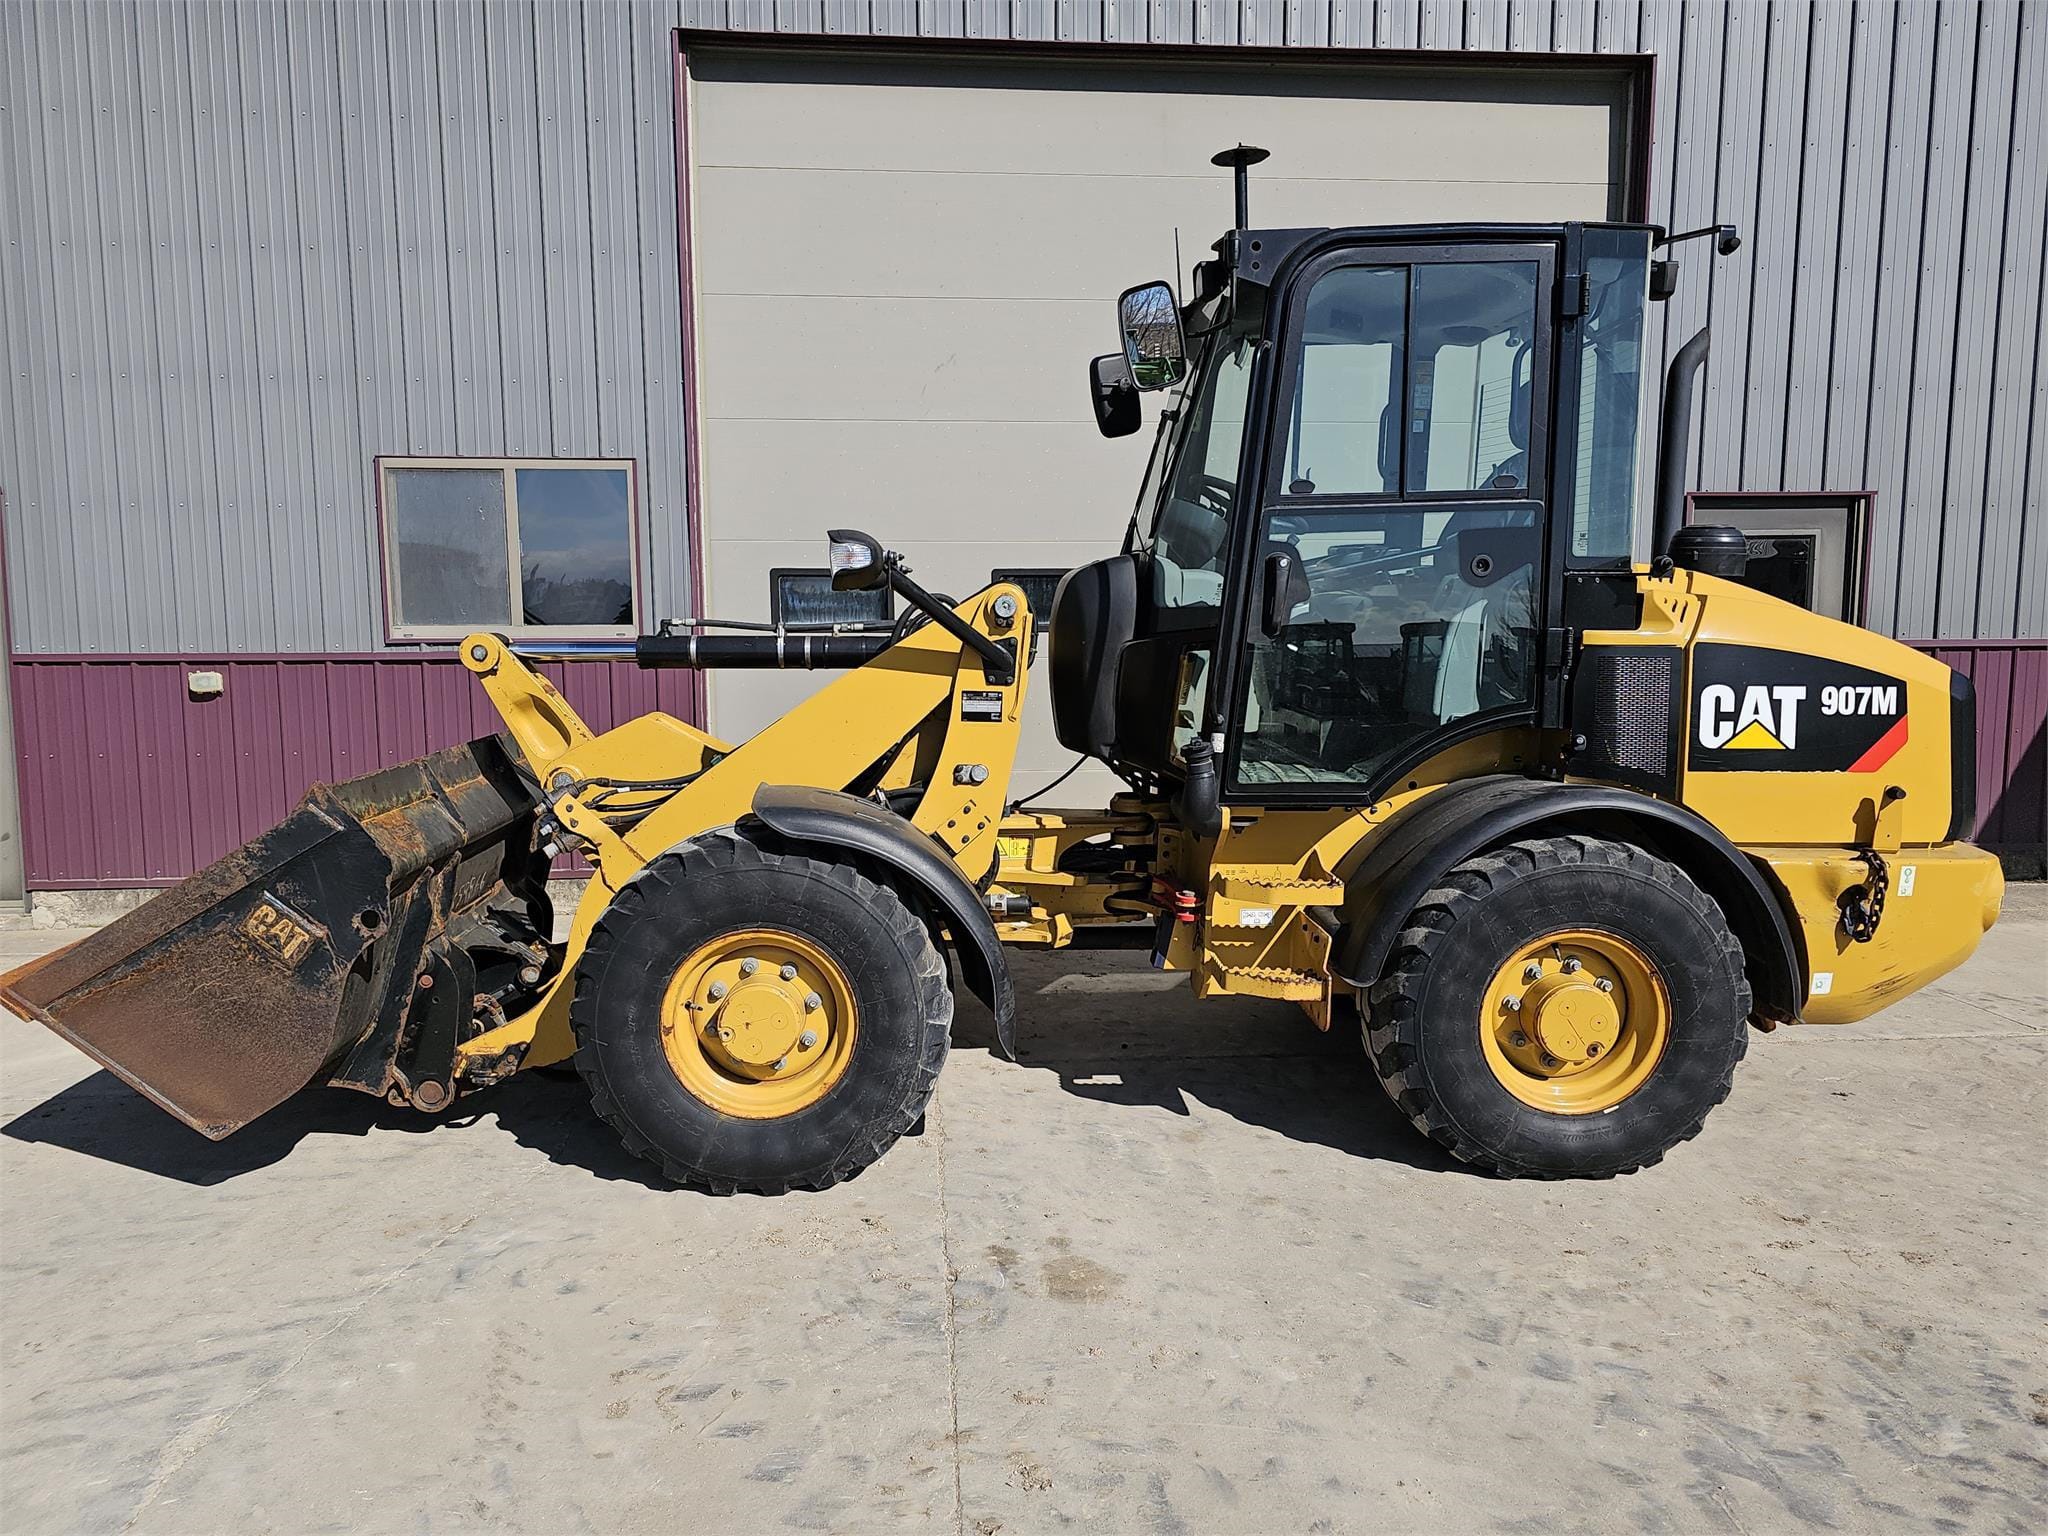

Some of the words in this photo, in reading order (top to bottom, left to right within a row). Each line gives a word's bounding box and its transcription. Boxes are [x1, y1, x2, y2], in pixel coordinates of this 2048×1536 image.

[1699, 684, 1806, 749] CAT
[1821, 686, 1897, 715] 907M
[247, 905, 309, 959] CAT
